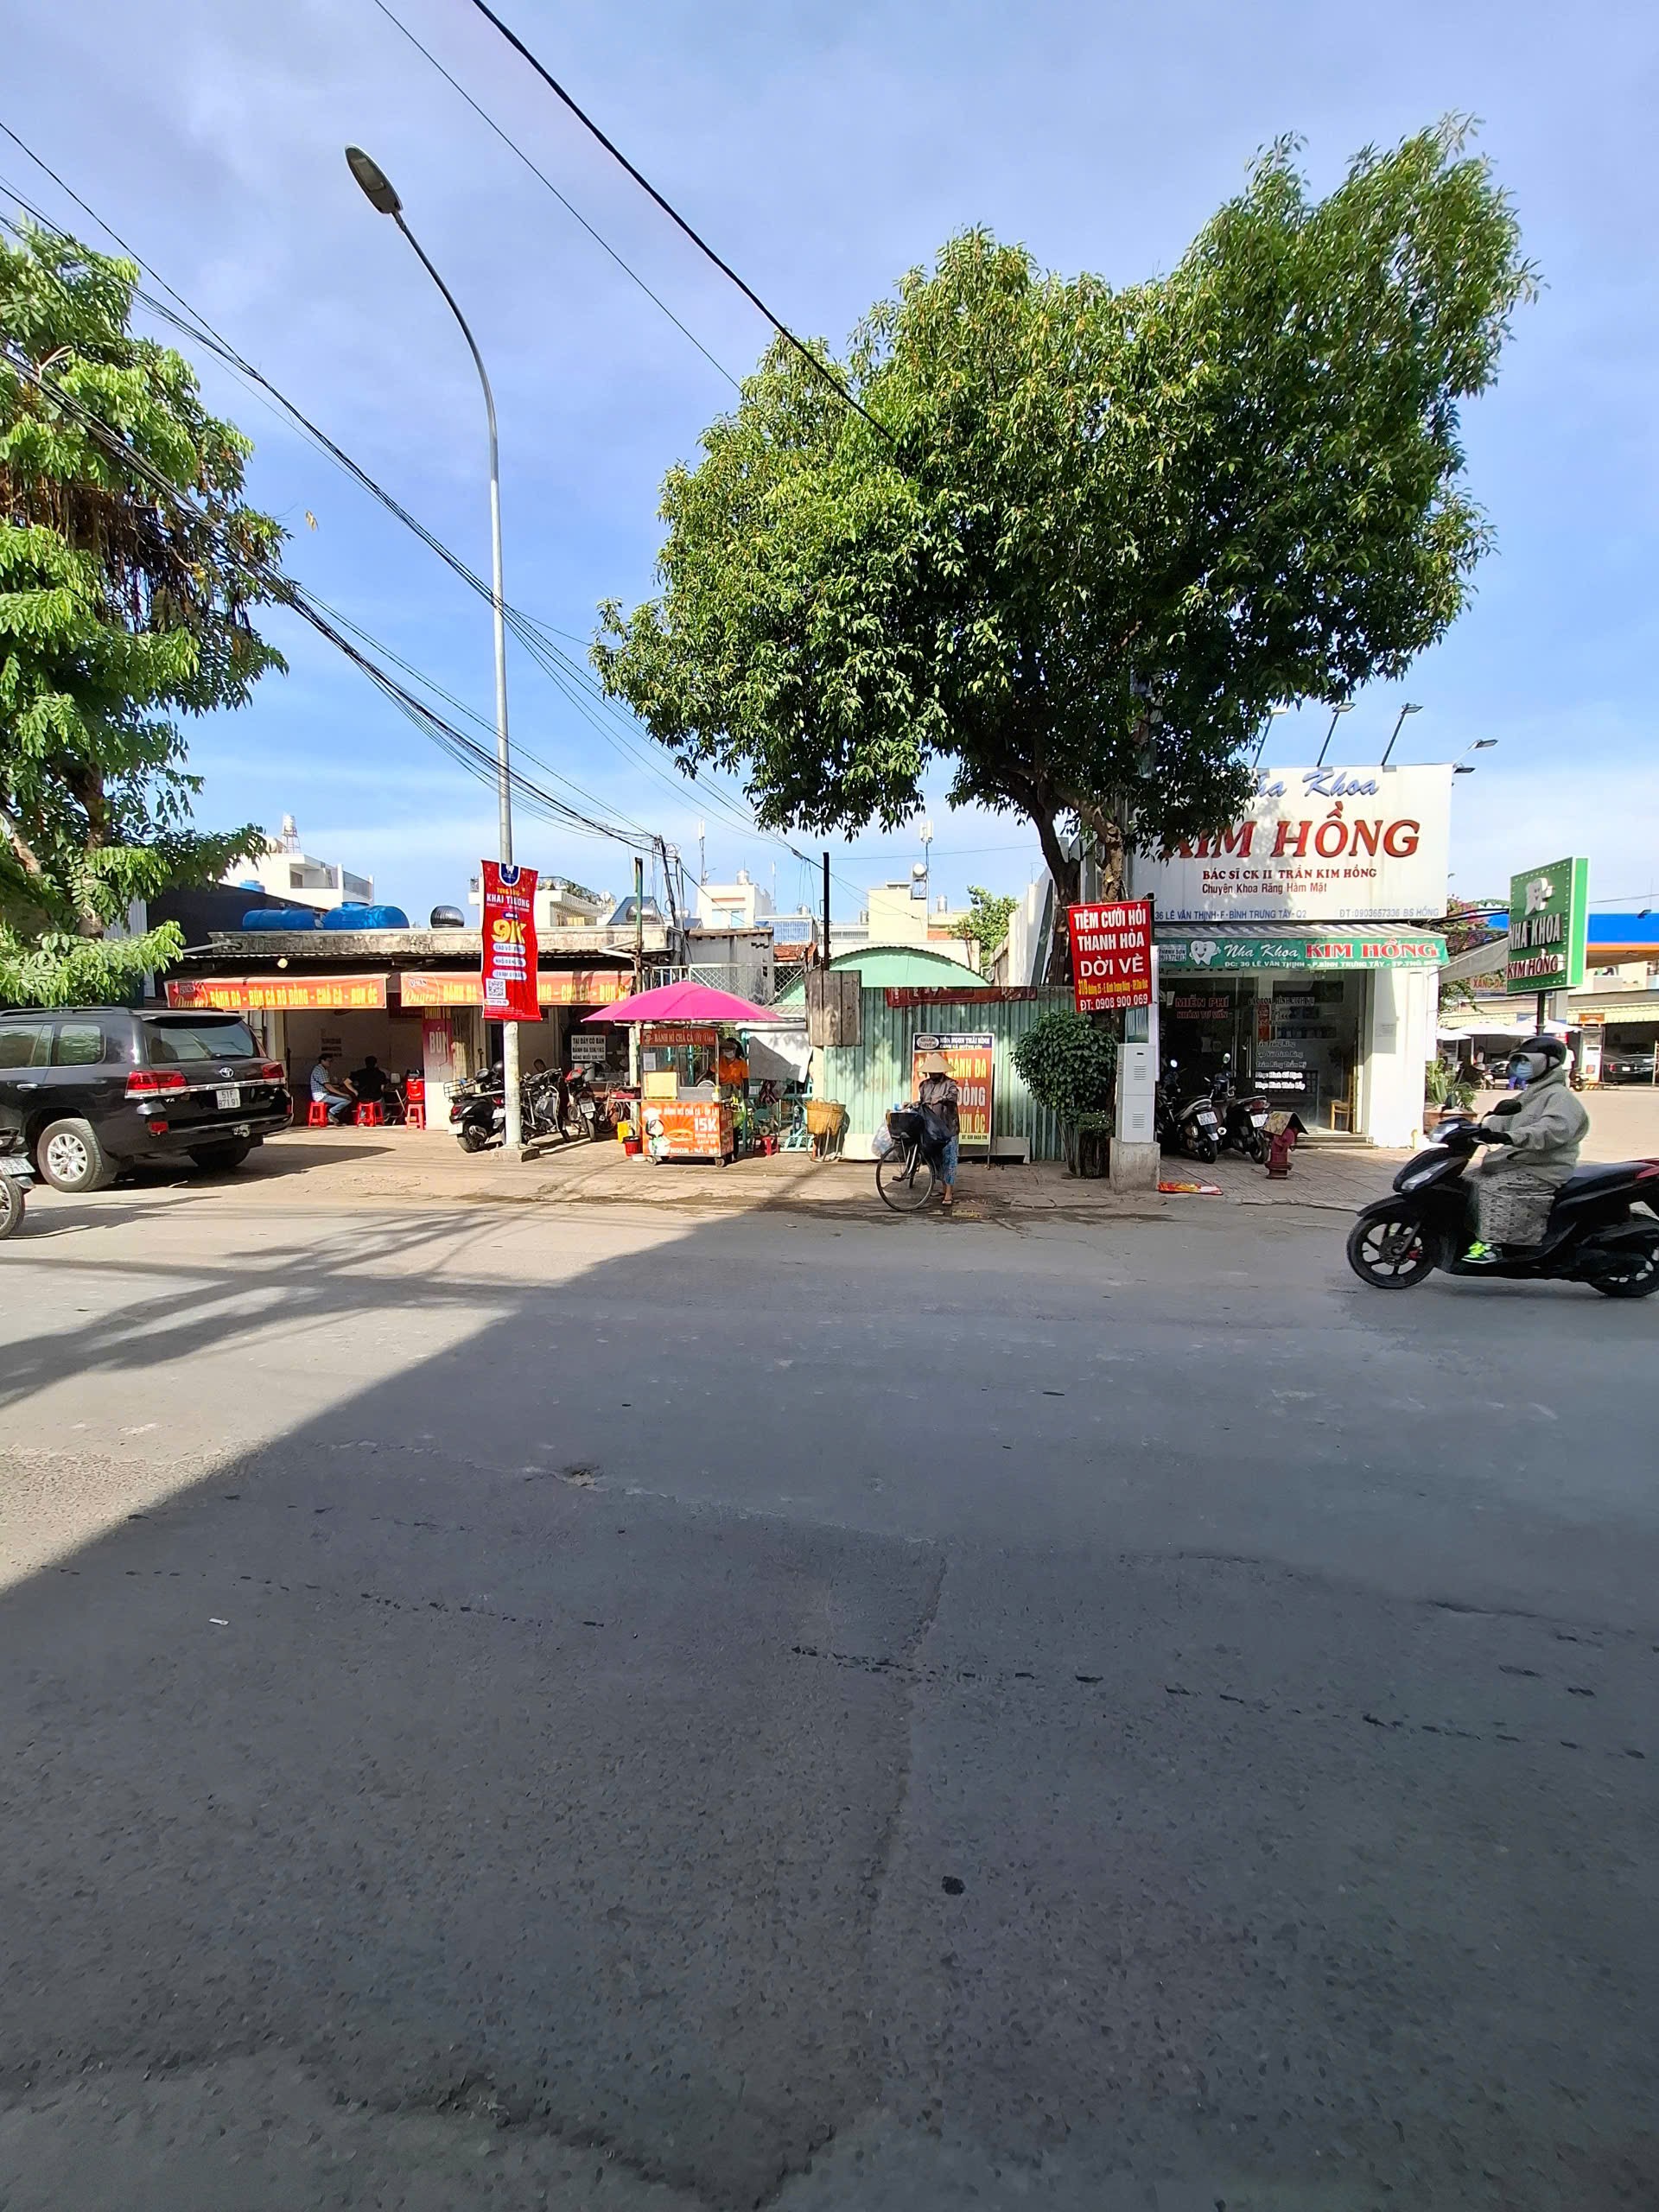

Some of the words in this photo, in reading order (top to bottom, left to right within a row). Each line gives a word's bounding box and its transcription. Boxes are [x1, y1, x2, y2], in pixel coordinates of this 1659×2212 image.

[1255, 772, 1287, 798] ha
[1302, 770, 1380, 797] Khoa
[1270, 800, 1420, 858] HỒNG
[1203, 867, 1226, 880] BÁC
[1229, 867, 1240, 880] SĨ
[1243, 870, 1259, 880] CK
[1262, 869, 1272, 880] II
[1278, 864, 1313, 879] TRẦN
[1316, 869, 1340, 879] KIM
[1344, 864, 1377, 878] HỒNG
[487, 893, 504, 904] KHAI
[1202, 883, 1233, 895] Chuyên
[1236, 883, 1258, 893] Khoa
[1262, 883, 1283, 895] Răng
[1287, 882, 1306, 893] Hàm
[1310, 882, 1326, 893] Mặt
[1074, 910, 1099, 932] TIỆM
[1101, 907, 1126, 928] CƯỚI
[1128, 903, 1146, 925] HỎI
[1155, 911, 1163, 920] 36
[1166, 909, 1175, 919] LÊ
[1177, 909, 1192, 920] VĂN
[1249, 909, 1276, 918] TRƯNG
[1403, 908, 1414, 918] BS
[1416, 906, 1439, 917] HỒNG
[491, 918, 527, 944] 9K
[1077, 933, 1116, 951] THANH
[1119, 928, 1145, 949] HÒA
[1509, 921, 1529, 950] NHA
[1531, 912, 1562, 946] KHOA
[1224, 944, 1255, 957] Nha
[1261, 944, 1300, 957] Khoa
[1306, 943, 1353, 959] KIM
[1361, 938, 1440, 959] HỒNG
[1080, 956, 1113, 977] DỜI
[1118, 953, 1144, 974] VỀ
[1507, 960, 1526, 979] KIM
[210, 988, 230, 1007] BÁNH
[231, 990, 242, 1007] ĐA
[249, 986, 264, 1007] BÚN
[265, 986, 276, 1006] CÁ
[288, 983, 308, 1006] ĐỒNG
[316, 983, 331, 1005] CHẢ
[333, 985, 343, 1004] CÁ
[351, 985, 365, 1005] BÚN
[367, 982, 378, 1004] ỐC
[443, 982, 464, 1001] BÁNH
[599, 981, 616, 1002] BÚN
[1175, 994, 1206, 1007] MIỄN
[1209, 995, 1230, 1007] PHÍ
[1080, 999, 1094, 1011] ĐT:
[1096, 997, 1115, 1009] 0908
[1116, 995, 1131, 1007] 900
[1134, 993, 1148, 1005] 069
[974, 1058, 987, 1078] ĐA
[221, 1090, 234, 1099] 51F
[694, 1117, 718, 1132] 15K
[959, 1109, 972, 1134] ÚN
[974, 1106, 986, 1134] ỐC
